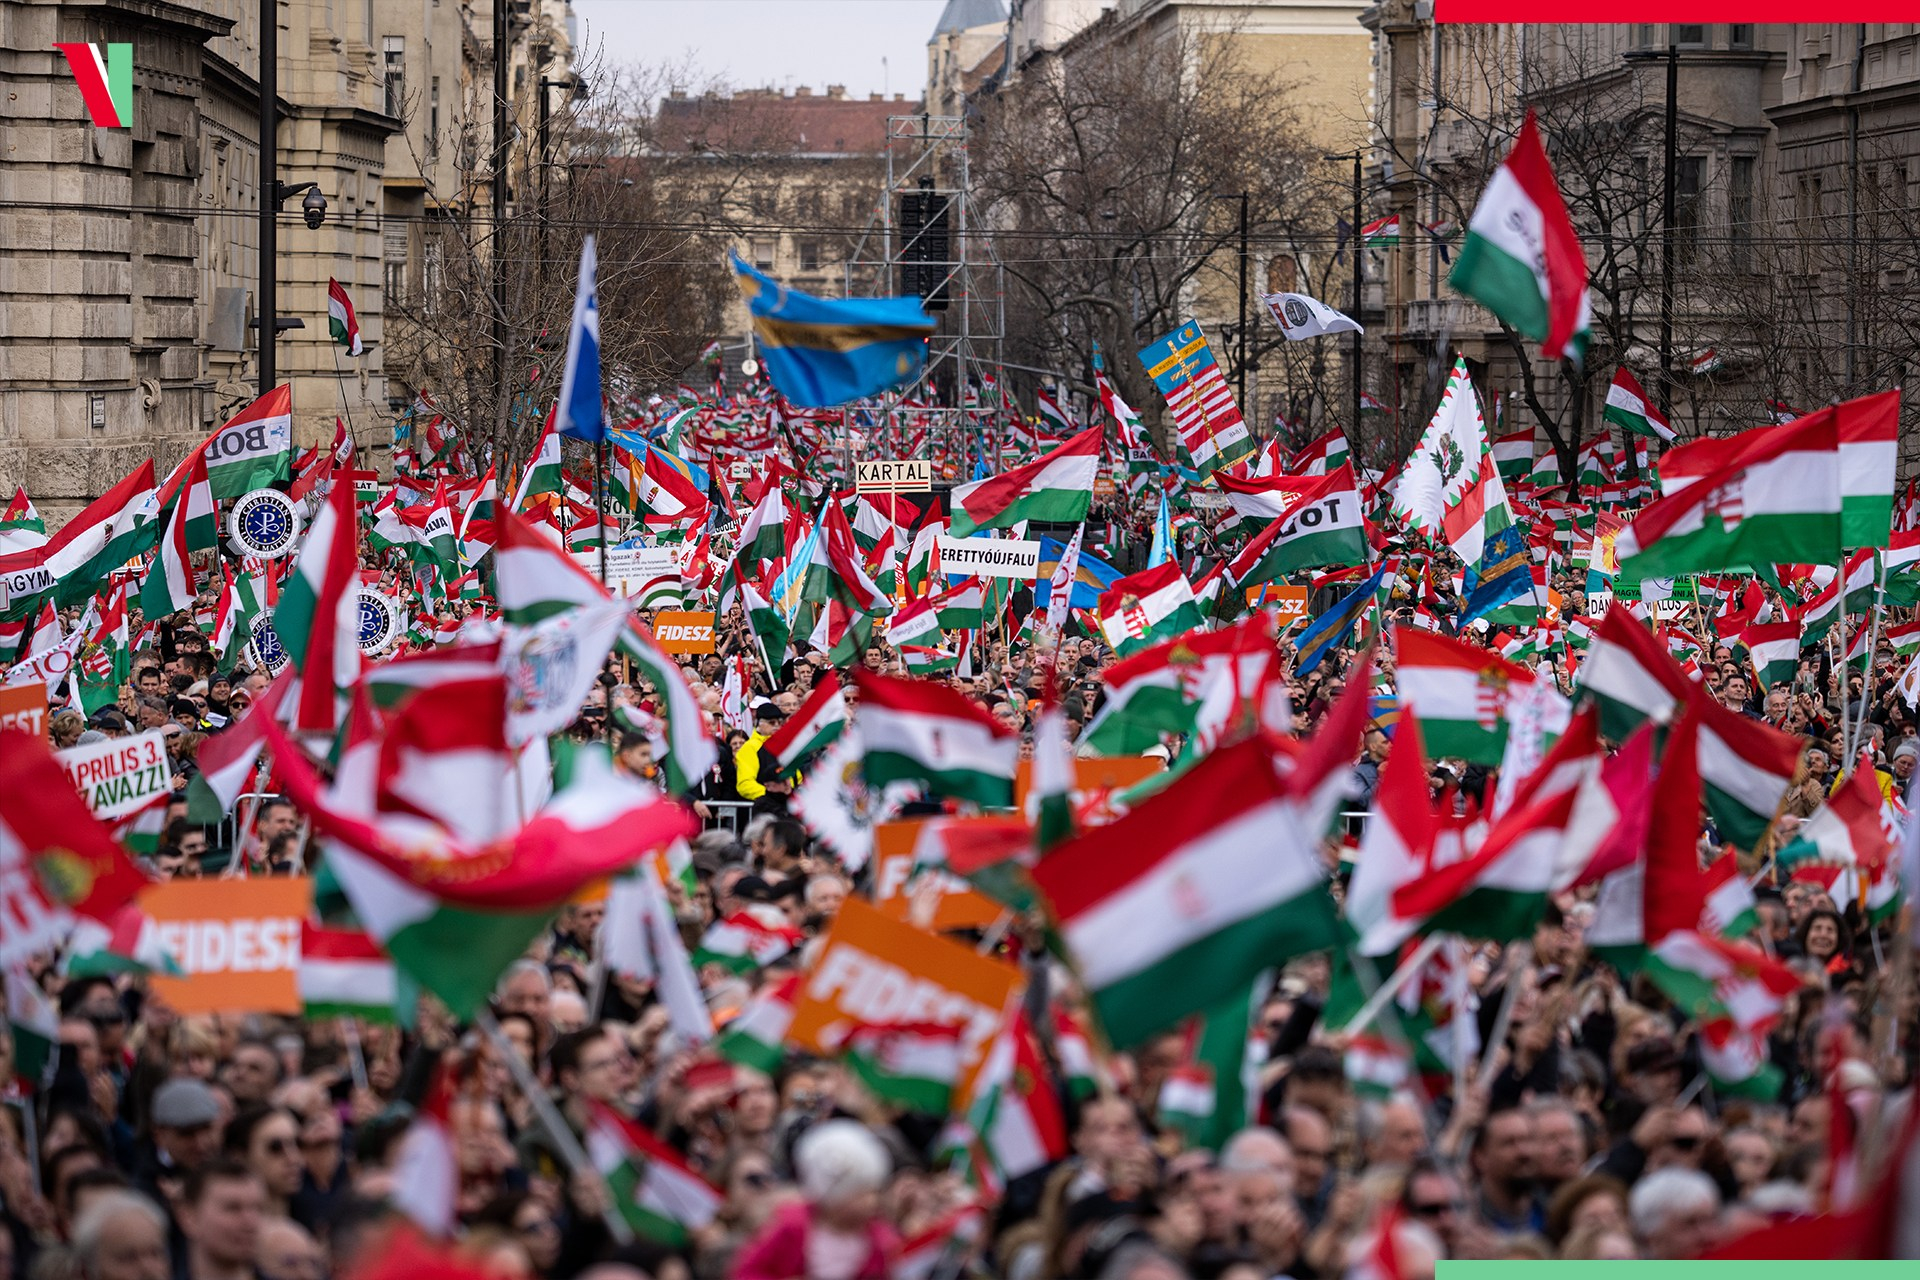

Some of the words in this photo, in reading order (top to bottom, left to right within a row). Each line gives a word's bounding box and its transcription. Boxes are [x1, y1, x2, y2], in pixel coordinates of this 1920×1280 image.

[858, 464, 928, 481] KARTAL
[242, 497, 290, 516] CHRISTIAN
[241, 531, 259, 551] LIVES
[262, 531, 290, 551] MATTER
[655, 624, 713, 642] FIDESZ
[144, 741, 162, 765] 3.
